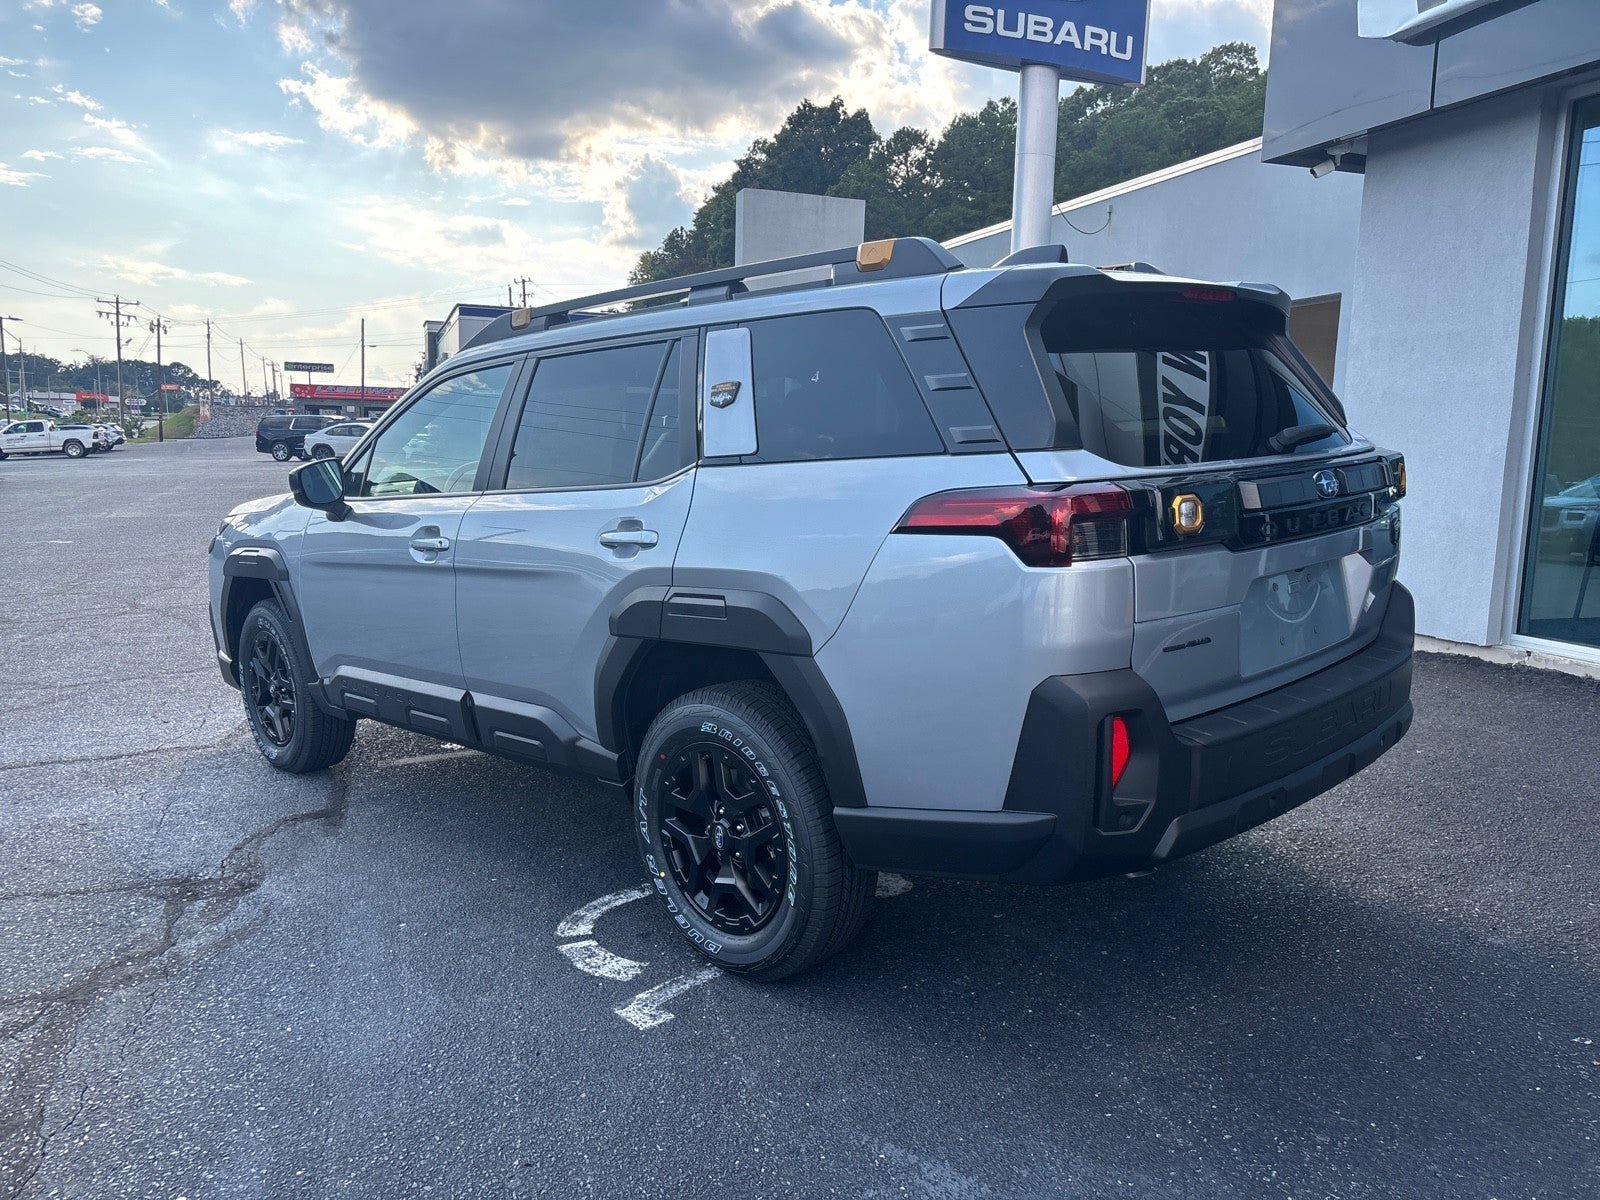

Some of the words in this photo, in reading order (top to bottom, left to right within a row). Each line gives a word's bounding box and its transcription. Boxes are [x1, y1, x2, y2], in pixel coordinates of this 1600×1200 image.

[964, 4, 1133, 61] SUBARU
[286, 362, 334, 373] enterprise
[638, 787, 651, 844] A/T
[701, 721, 798, 907] BRIDGESTONE
[646, 854, 722, 955] DUELER
